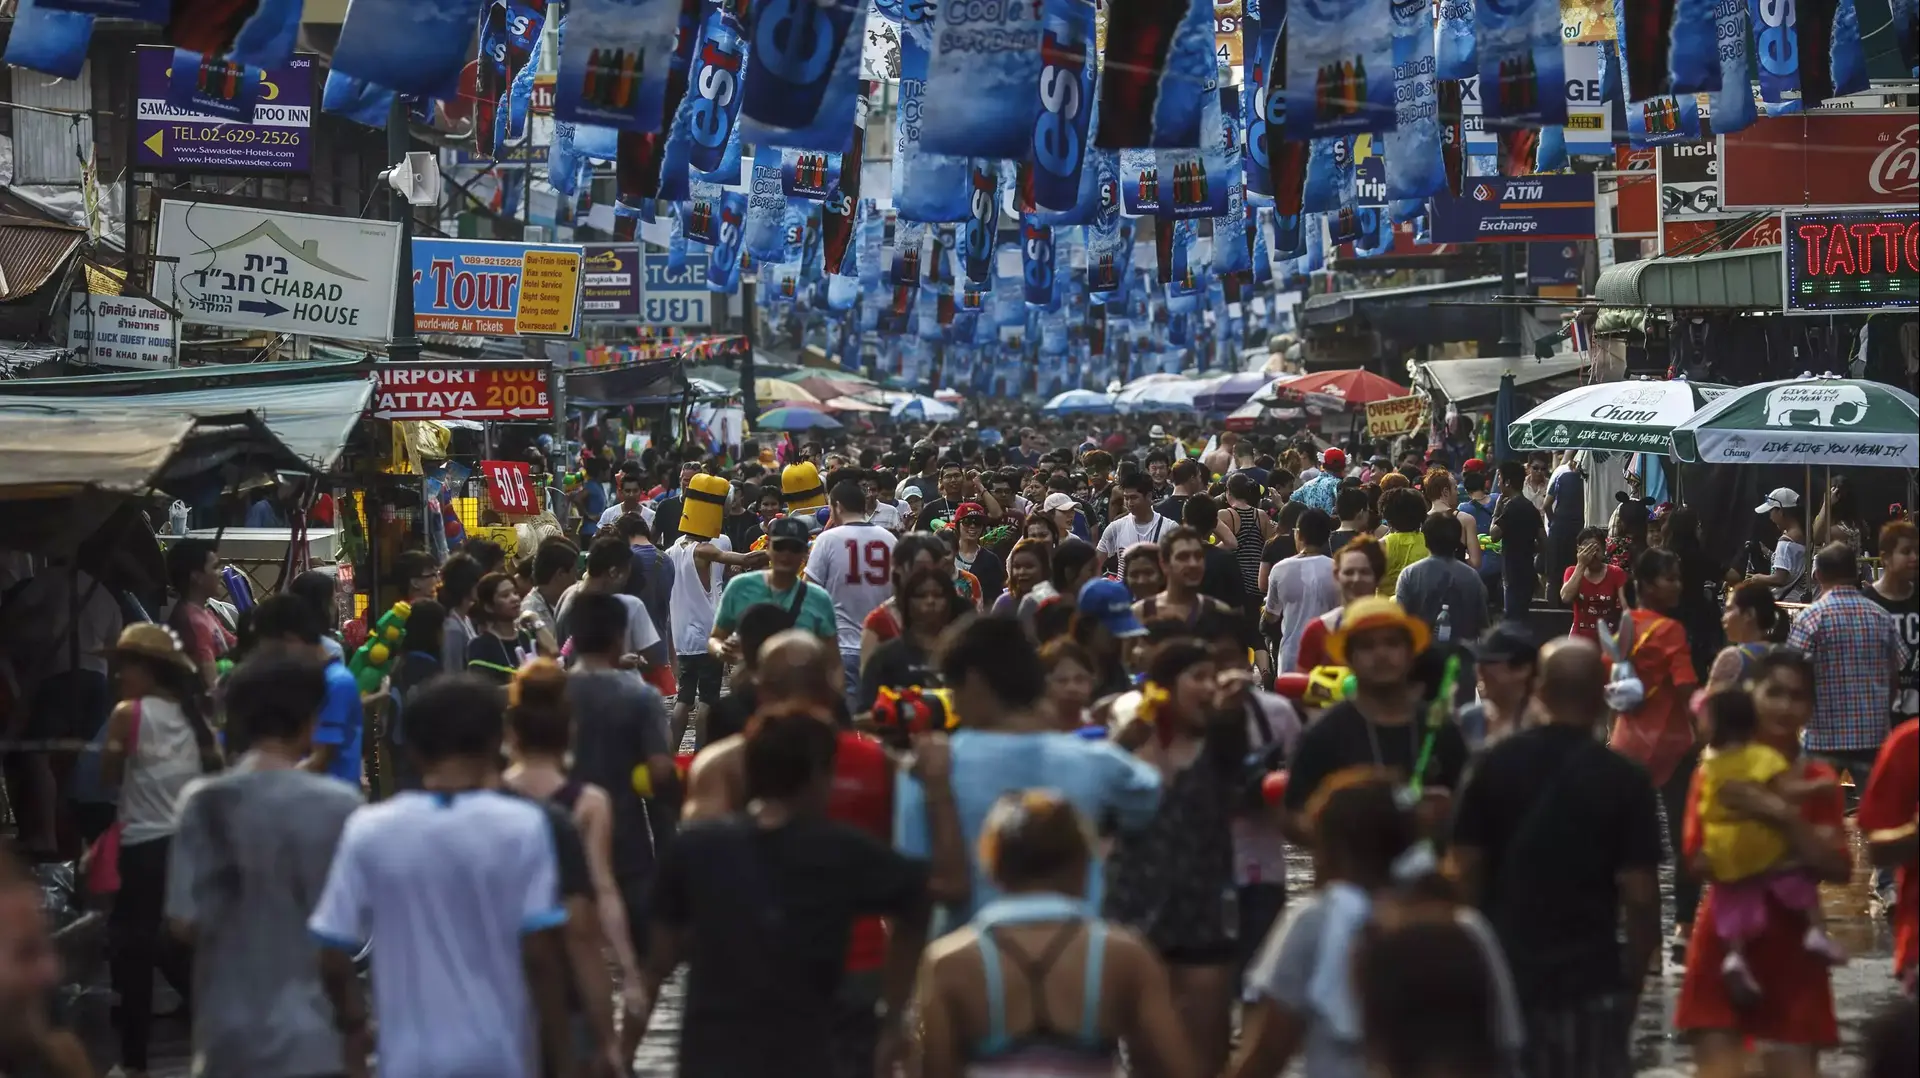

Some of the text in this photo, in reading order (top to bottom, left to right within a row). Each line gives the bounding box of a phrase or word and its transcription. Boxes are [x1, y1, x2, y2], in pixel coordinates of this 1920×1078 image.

[253, 107, 285, 121] MPOO
[288, 109, 309, 122] INN
[172, 126, 300, 146] TEL.02-629-2526
[173, 145, 295, 158] www.Sawasdee-Hotels.com
[178, 156, 292, 168] www.HotelSawasdee.com
[1356, 177, 1386, 202] Trip
[1503, 186, 1543, 200] ATM
[1479, 219, 1538, 232] Exchange
[244, 253, 289, 275] בית
[464, 256, 522, 267] 089-9215228
[260, 276, 343, 302] CHABAD
[430, 256, 518, 312] Tour
[293, 303, 360, 326] HOUSE
[645, 297, 705, 323] ยยา
[417, 318, 504, 332] world-wide Air Tickets
[97, 331, 118, 342] LUCK
[120, 333, 146, 345] GUEST
[116, 350, 137, 360] KHAO
[142, 352, 158, 362] SAN
[1778, 394, 1799, 403] YOU
[1781, 388, 1841, 396] LIVE LIKE
[1590, 404, 1659, 424] Chang
[1371, 419, 1403, 435] CALL
[1550, 435, 1570, 445] Chang
[1577, 429, 1600, 440] LIVE
[1598, 431, 1622, 442] LIKE
[1620, 431, 1636, 442] YOU
[1637, 433, 1661, 446] MEAN
[1723, 447, 1751, 459] Chang
[1761, 442, 1790, 453] LIVE
[1792, 442, 1824, 453] LIKE
[1824, 443, 1852, 455] YOU
[1850, 443, 1883, 456] MEAN
[844, 539, 891, 586] 19
